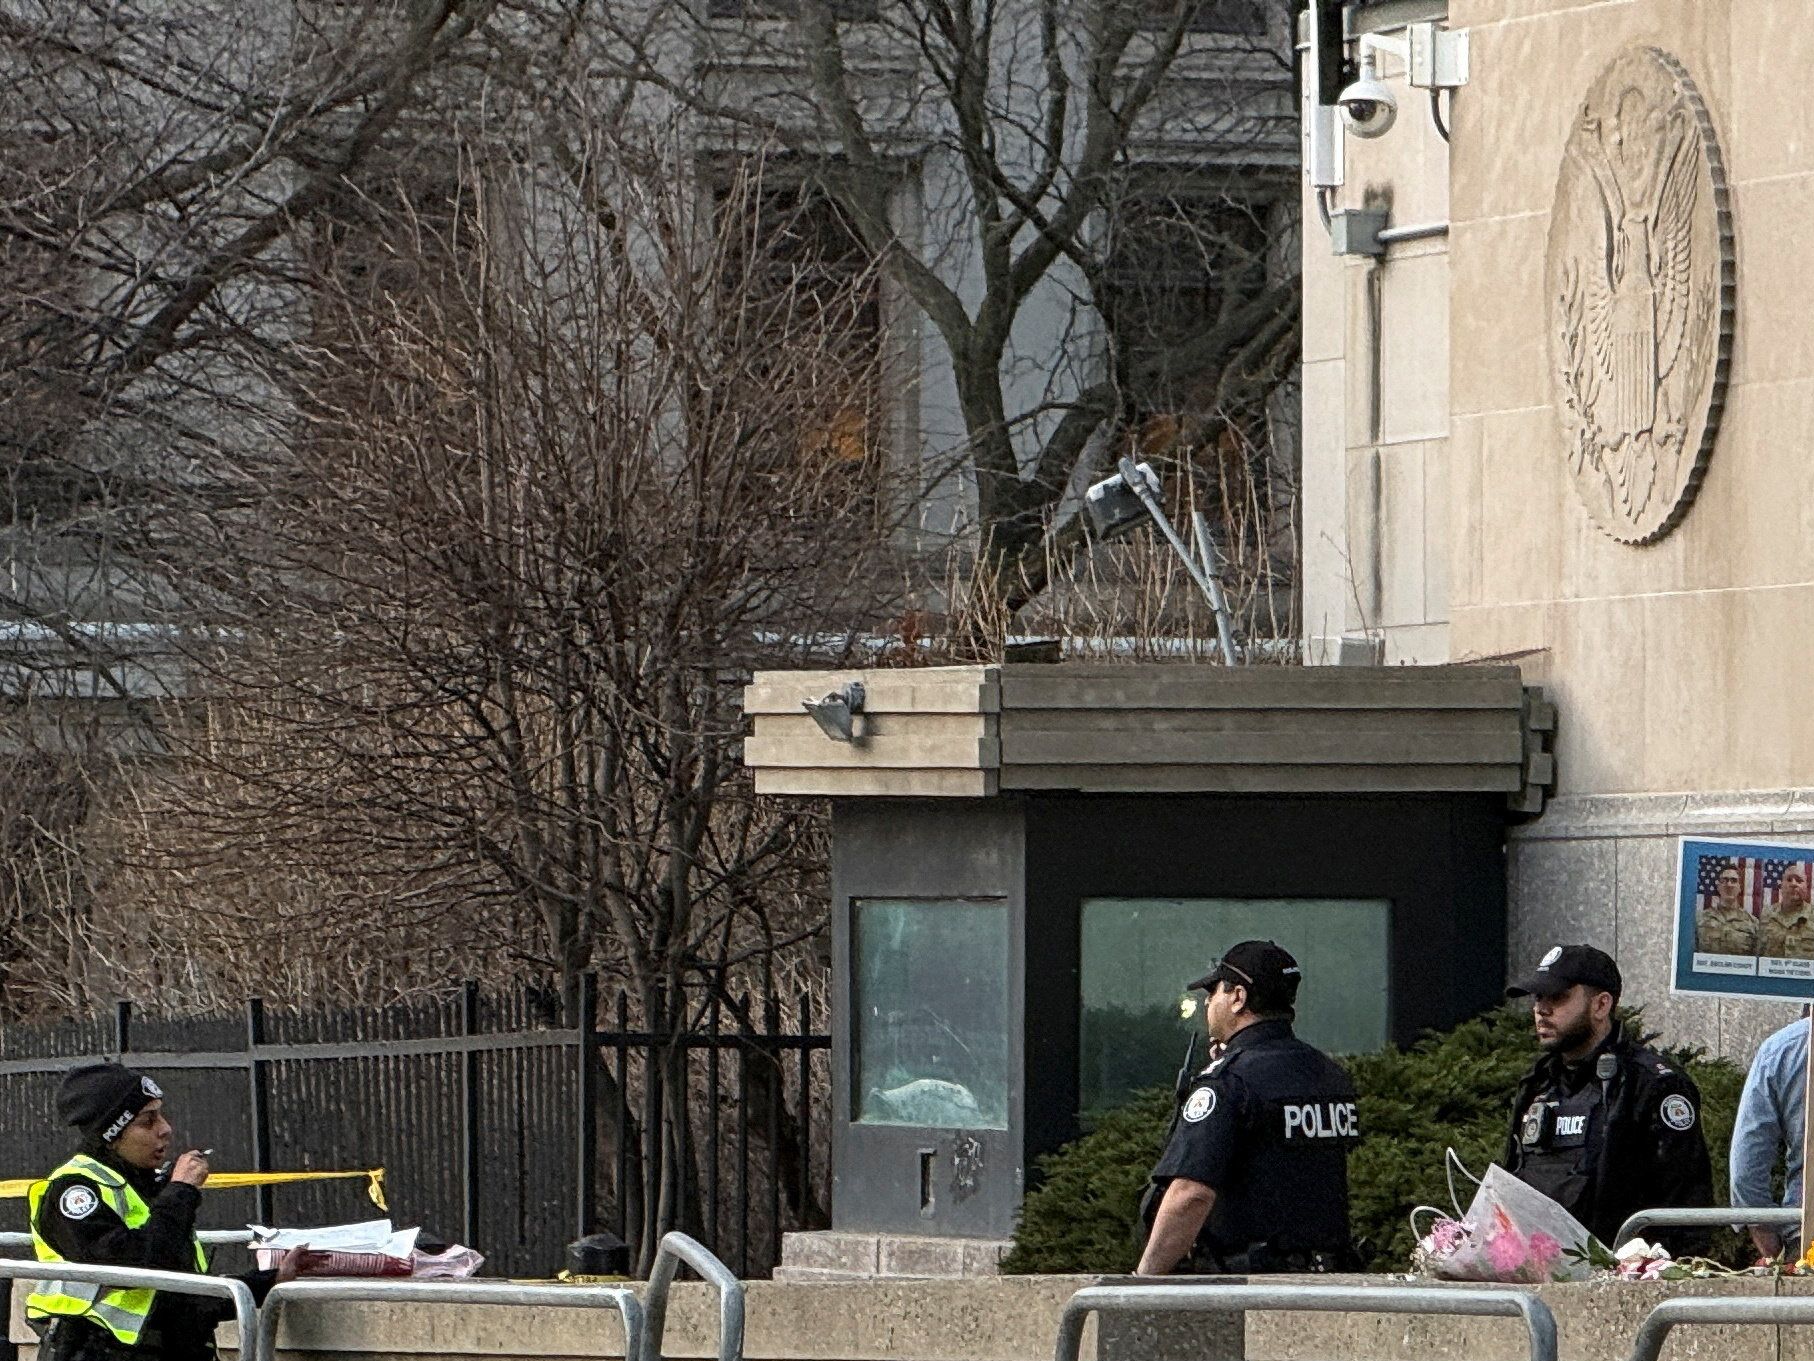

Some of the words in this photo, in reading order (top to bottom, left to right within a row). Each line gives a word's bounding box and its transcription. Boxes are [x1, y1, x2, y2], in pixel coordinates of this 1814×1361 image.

[102, 1109, 135, 1143] POLICE
[1283, 1102, 1360, 1139] POLICE
[1555, 1114, 1587, 1136] POLICE
